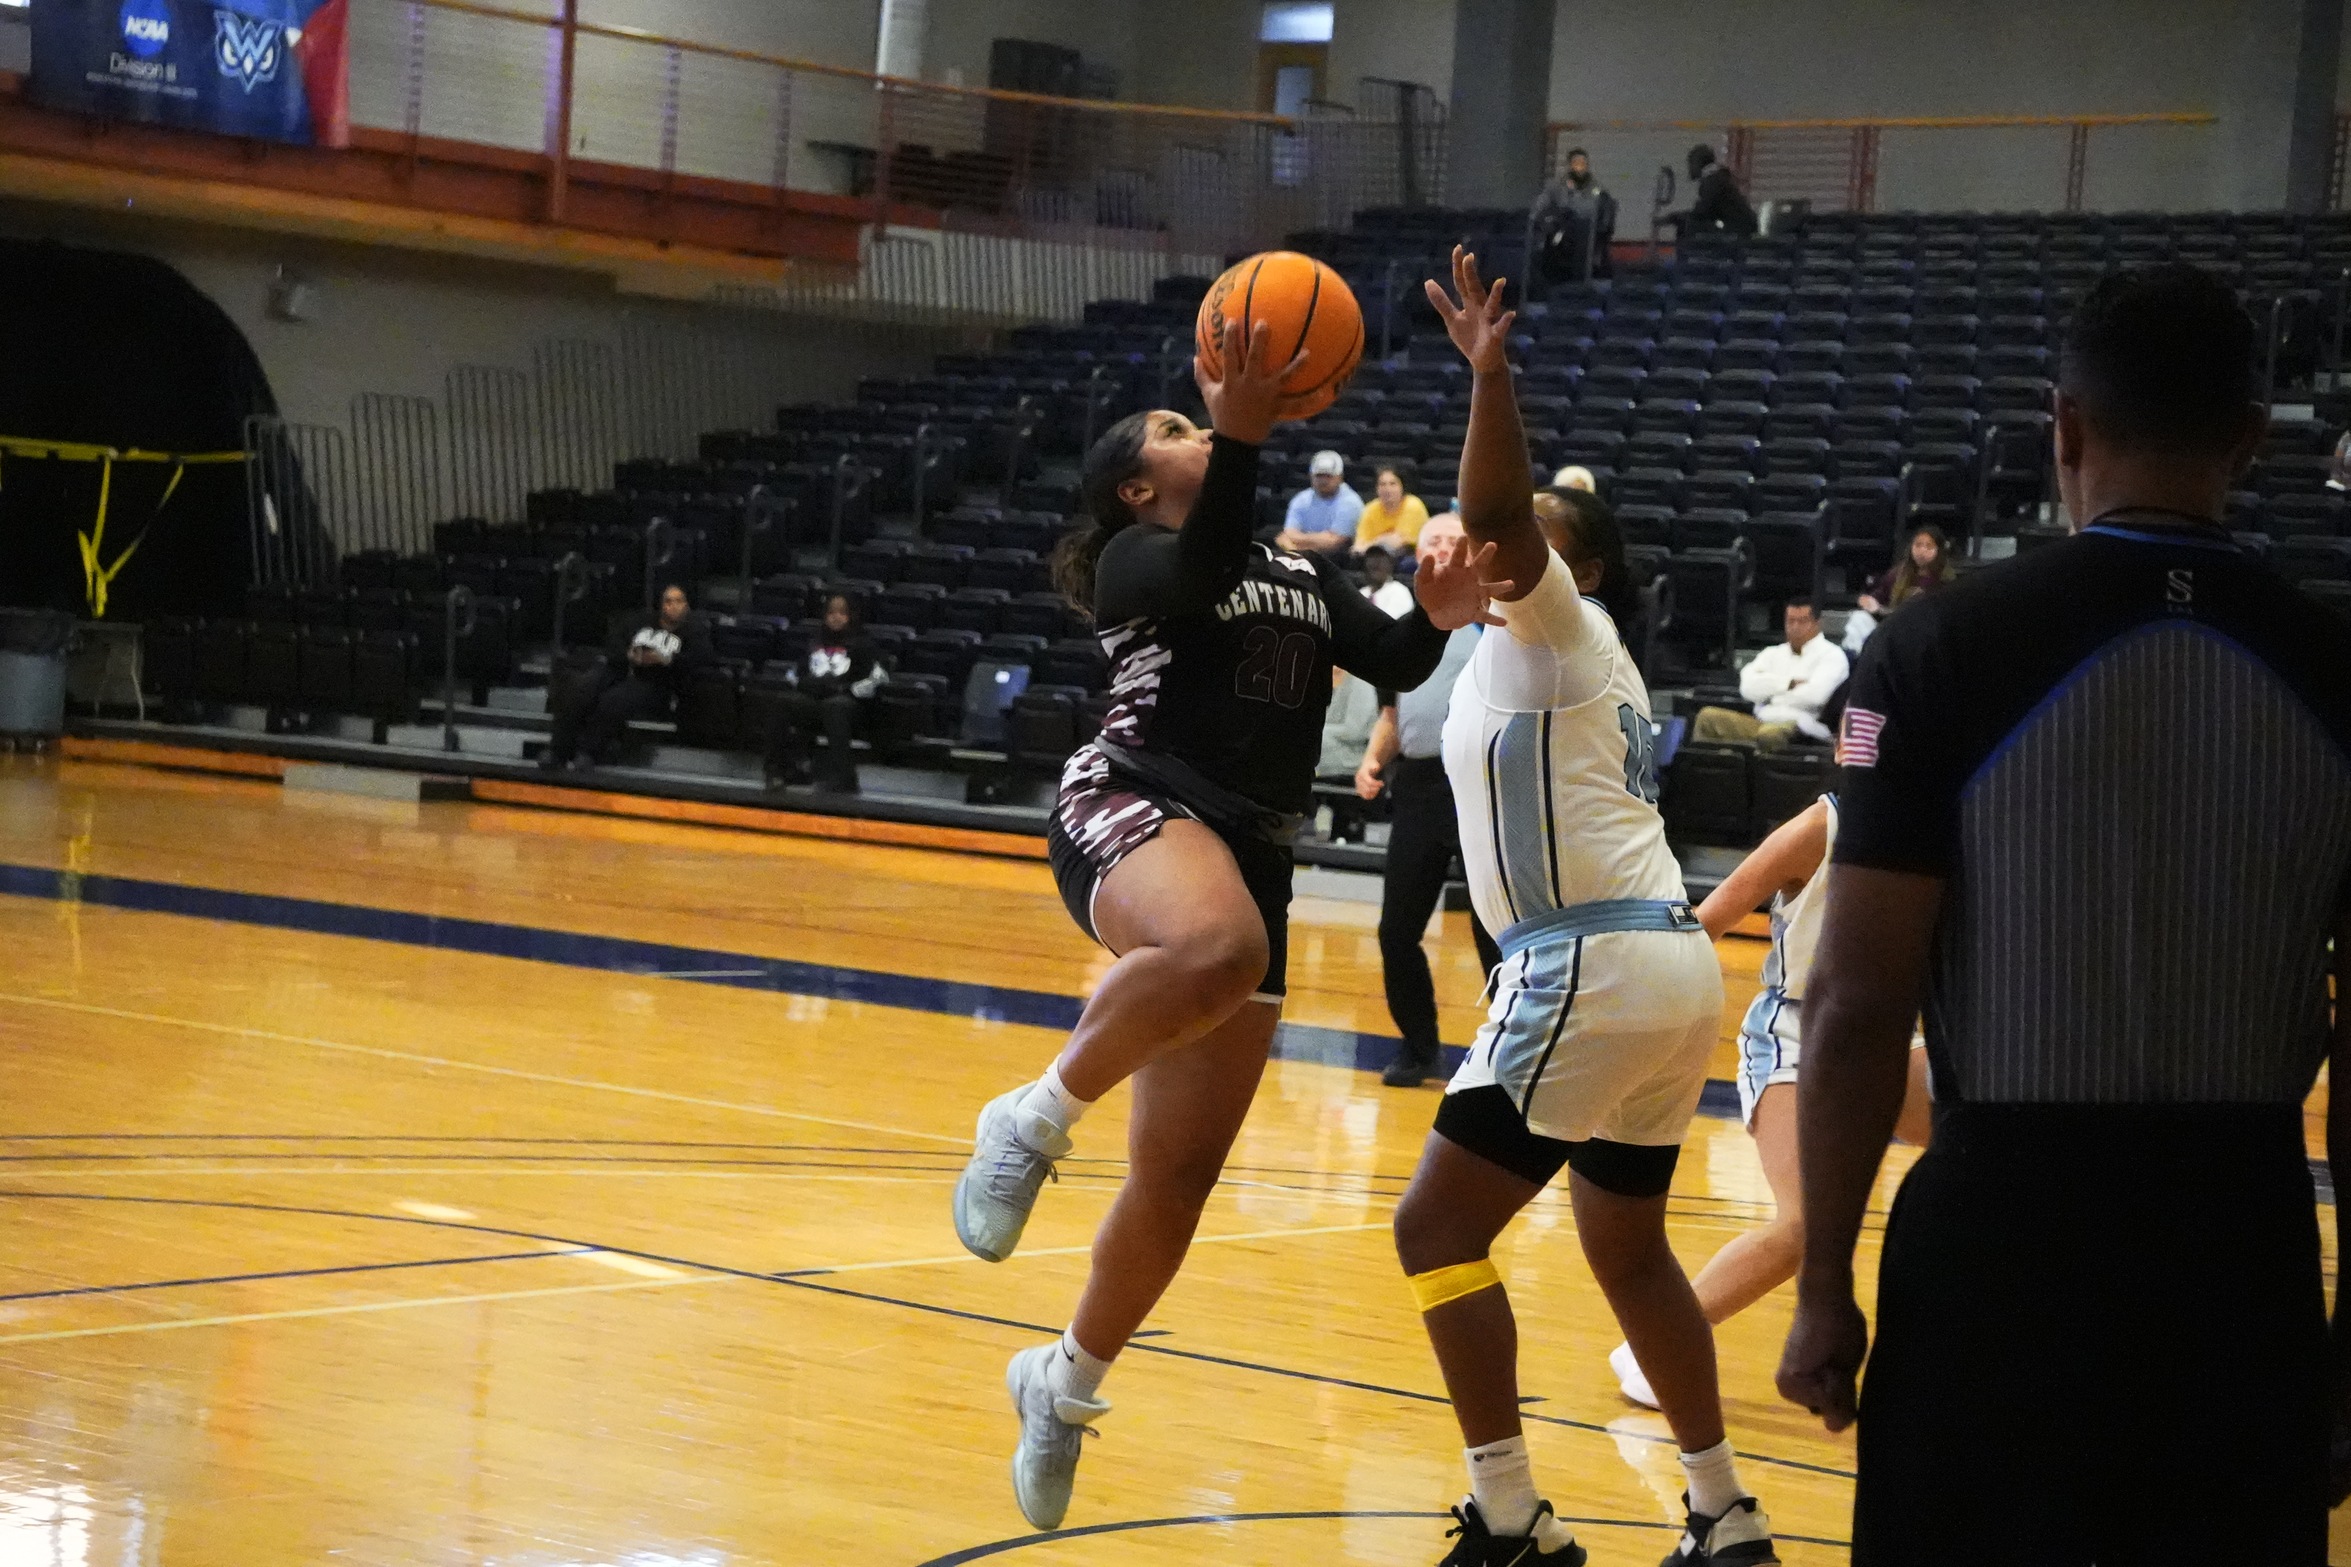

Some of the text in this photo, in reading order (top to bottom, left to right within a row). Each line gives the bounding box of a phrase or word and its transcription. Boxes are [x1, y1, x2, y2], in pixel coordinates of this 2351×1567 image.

[125, 15, 169, 43] NCAA
[110, 51, 164, 79] Division
[1235, 624, 1316, 709] 20
